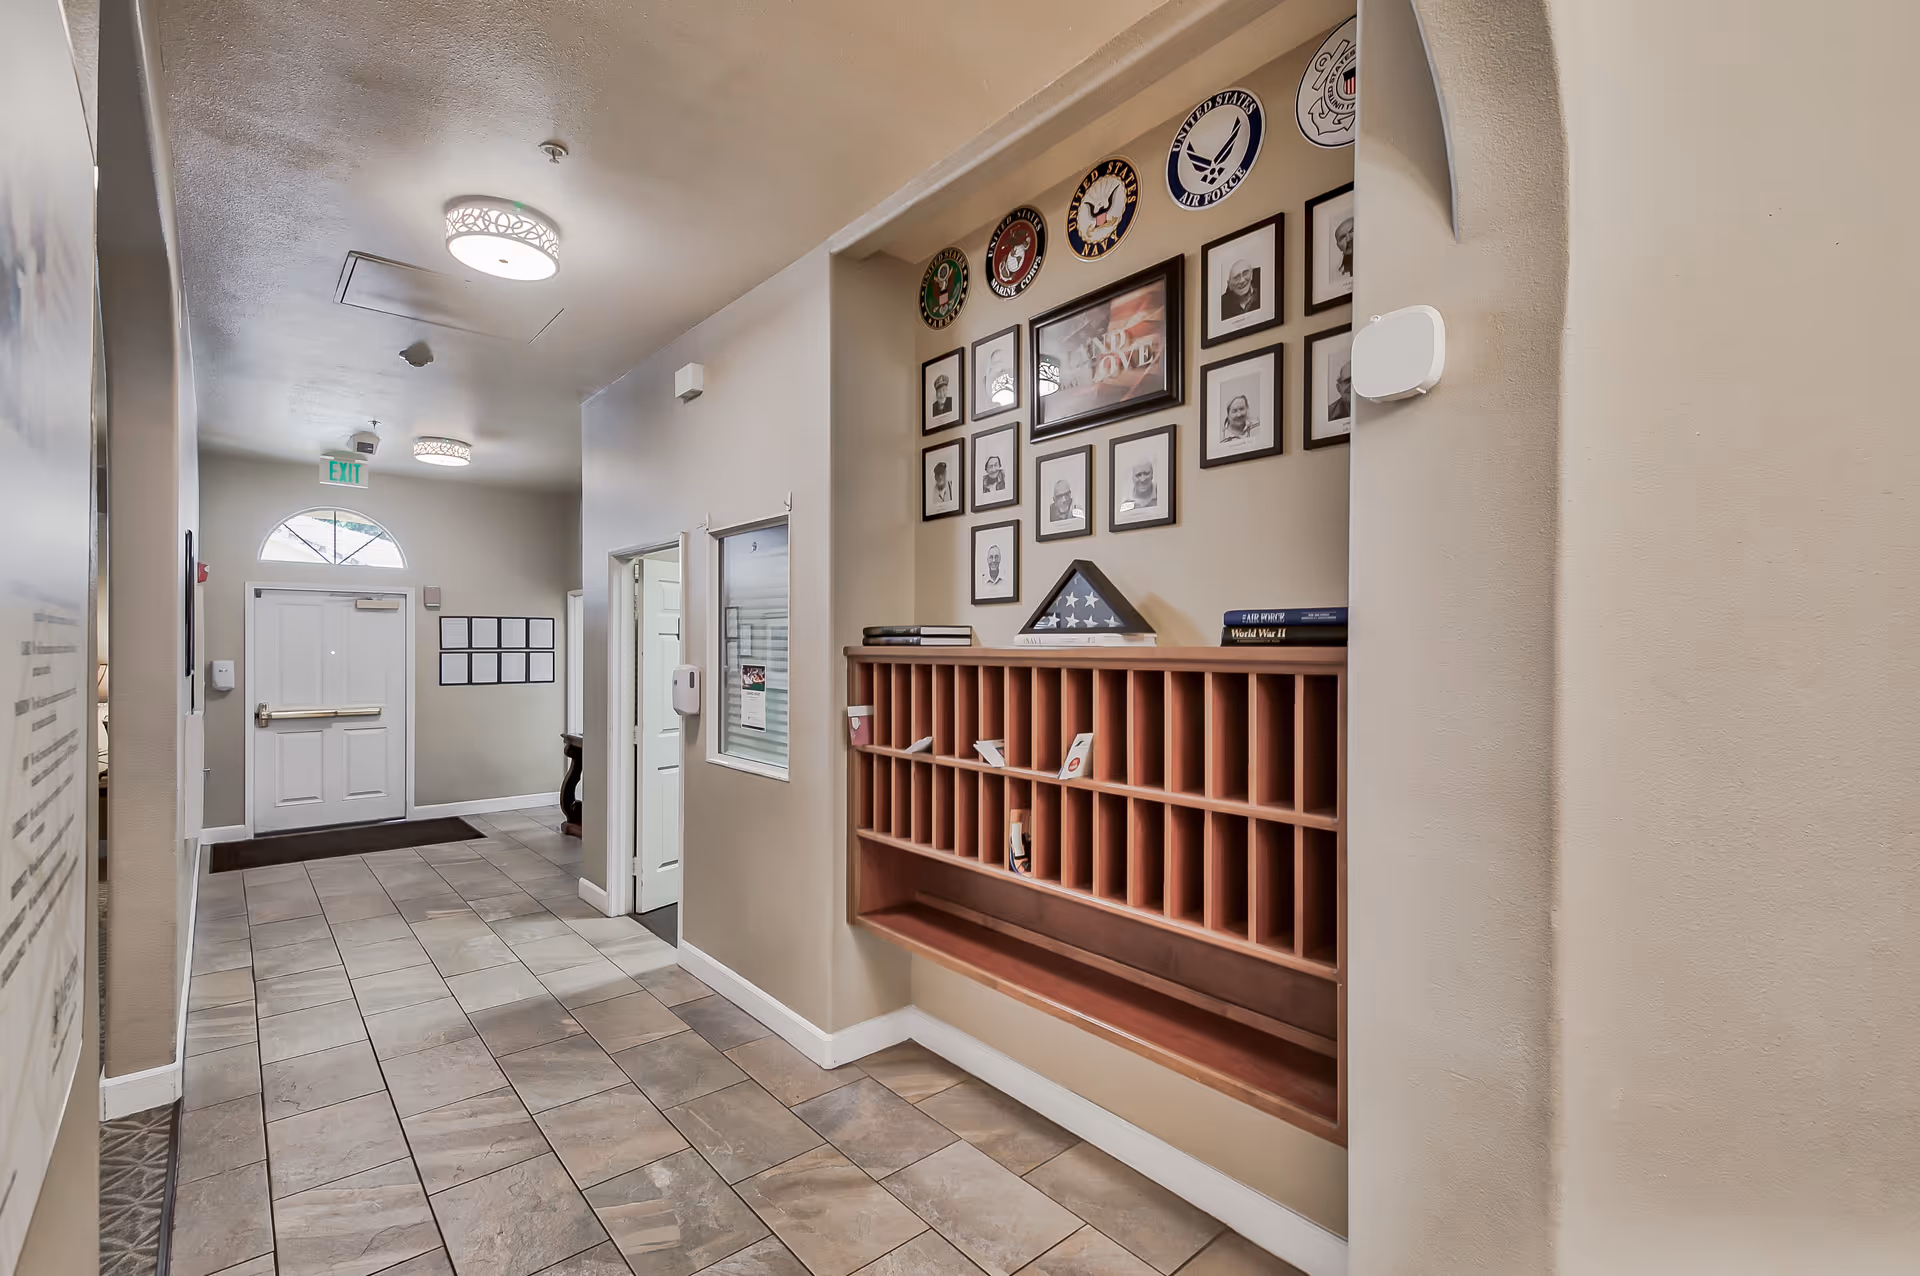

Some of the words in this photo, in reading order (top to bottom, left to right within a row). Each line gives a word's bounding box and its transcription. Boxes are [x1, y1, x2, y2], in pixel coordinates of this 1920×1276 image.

[1172, 100, 1212, 152] UNITED
[1215, 92, 1257, 115] STATES
[1068, 169, 1098, 232] UNITED
[1106, 161, 1136, 203] STATES
[1179, 191, 1200, 206] AIR
[1203, 166, 1246, 205] FORCE
[988, 216, 1012, 257] UNITED
[1017, 209, 1042, 232] STATES
[1081, 229, 1119, 256] NAVY
[990, 278, 1016, 296] MARINE
[1020, 255, 1042, 289] CORPS
[329, 460, 361, 484] EXIT
[1231, 628, 1257, 638] World
[1258, 628, 1276, 638] War
[1277, 628, 1287, 638] II
[1247, 613, 1259, 624] AIR
[1260, 611, 1285, 624] FORCE
